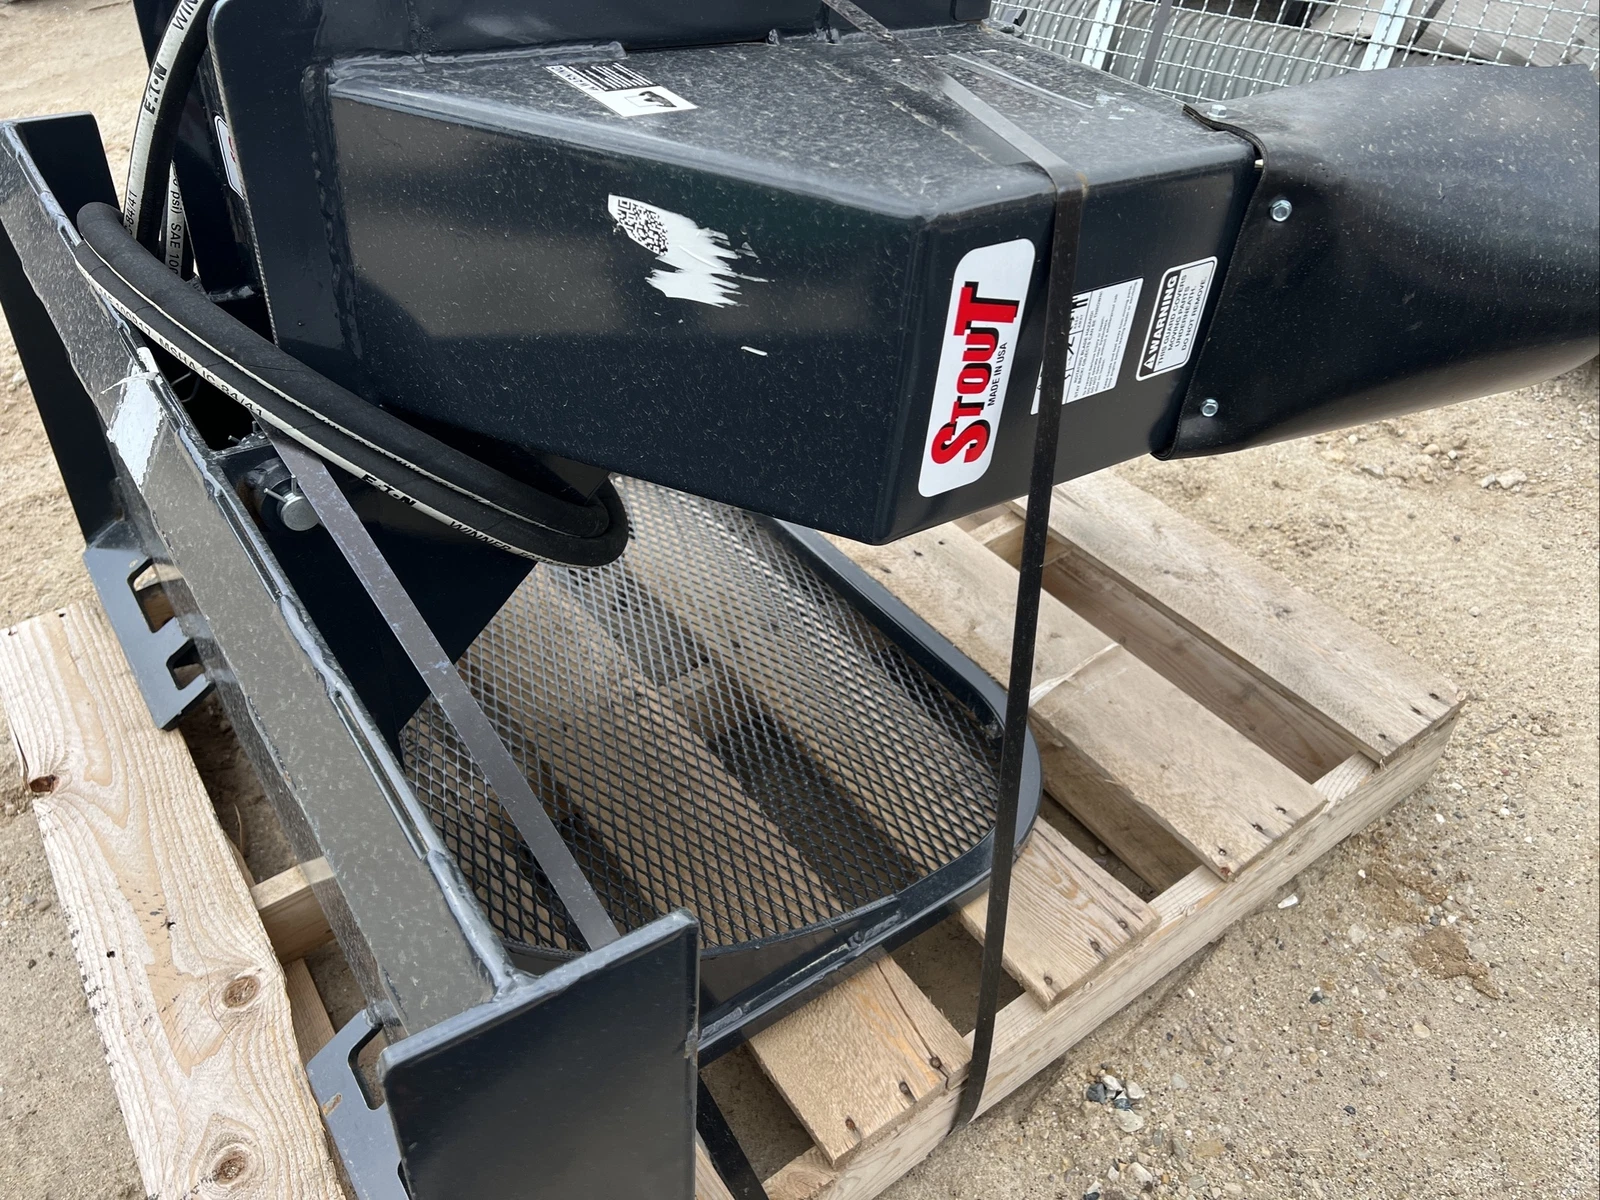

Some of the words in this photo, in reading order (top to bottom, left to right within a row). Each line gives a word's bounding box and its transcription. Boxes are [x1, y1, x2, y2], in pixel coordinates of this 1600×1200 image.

[170, 222, 182, 249] SAE
[1148, 275, 1177, 354] WARNING
[1157, 346, 1167, 364] THIS
[1163, 313, 1176, 344] GUARD
[1172, 274, 1187, 311] COVERS
[1167, 316, 1181, 350] MOVING
[1177, 286, 1190, 314] PARTS
[1174, 286, 1196, 346] UNDERNEATH.
[1180, 338, 1189, 350] DO
[1185, 318, 1194, 336] NOT
[1191, 276, 1207, 315] REMOVE.
[931, 281, 1020, 465] STOUT
[987, 377, 1000, 407] MADE
[997, 342, 1008, 362] USA
[450, 520, 512, 551] WINNER
